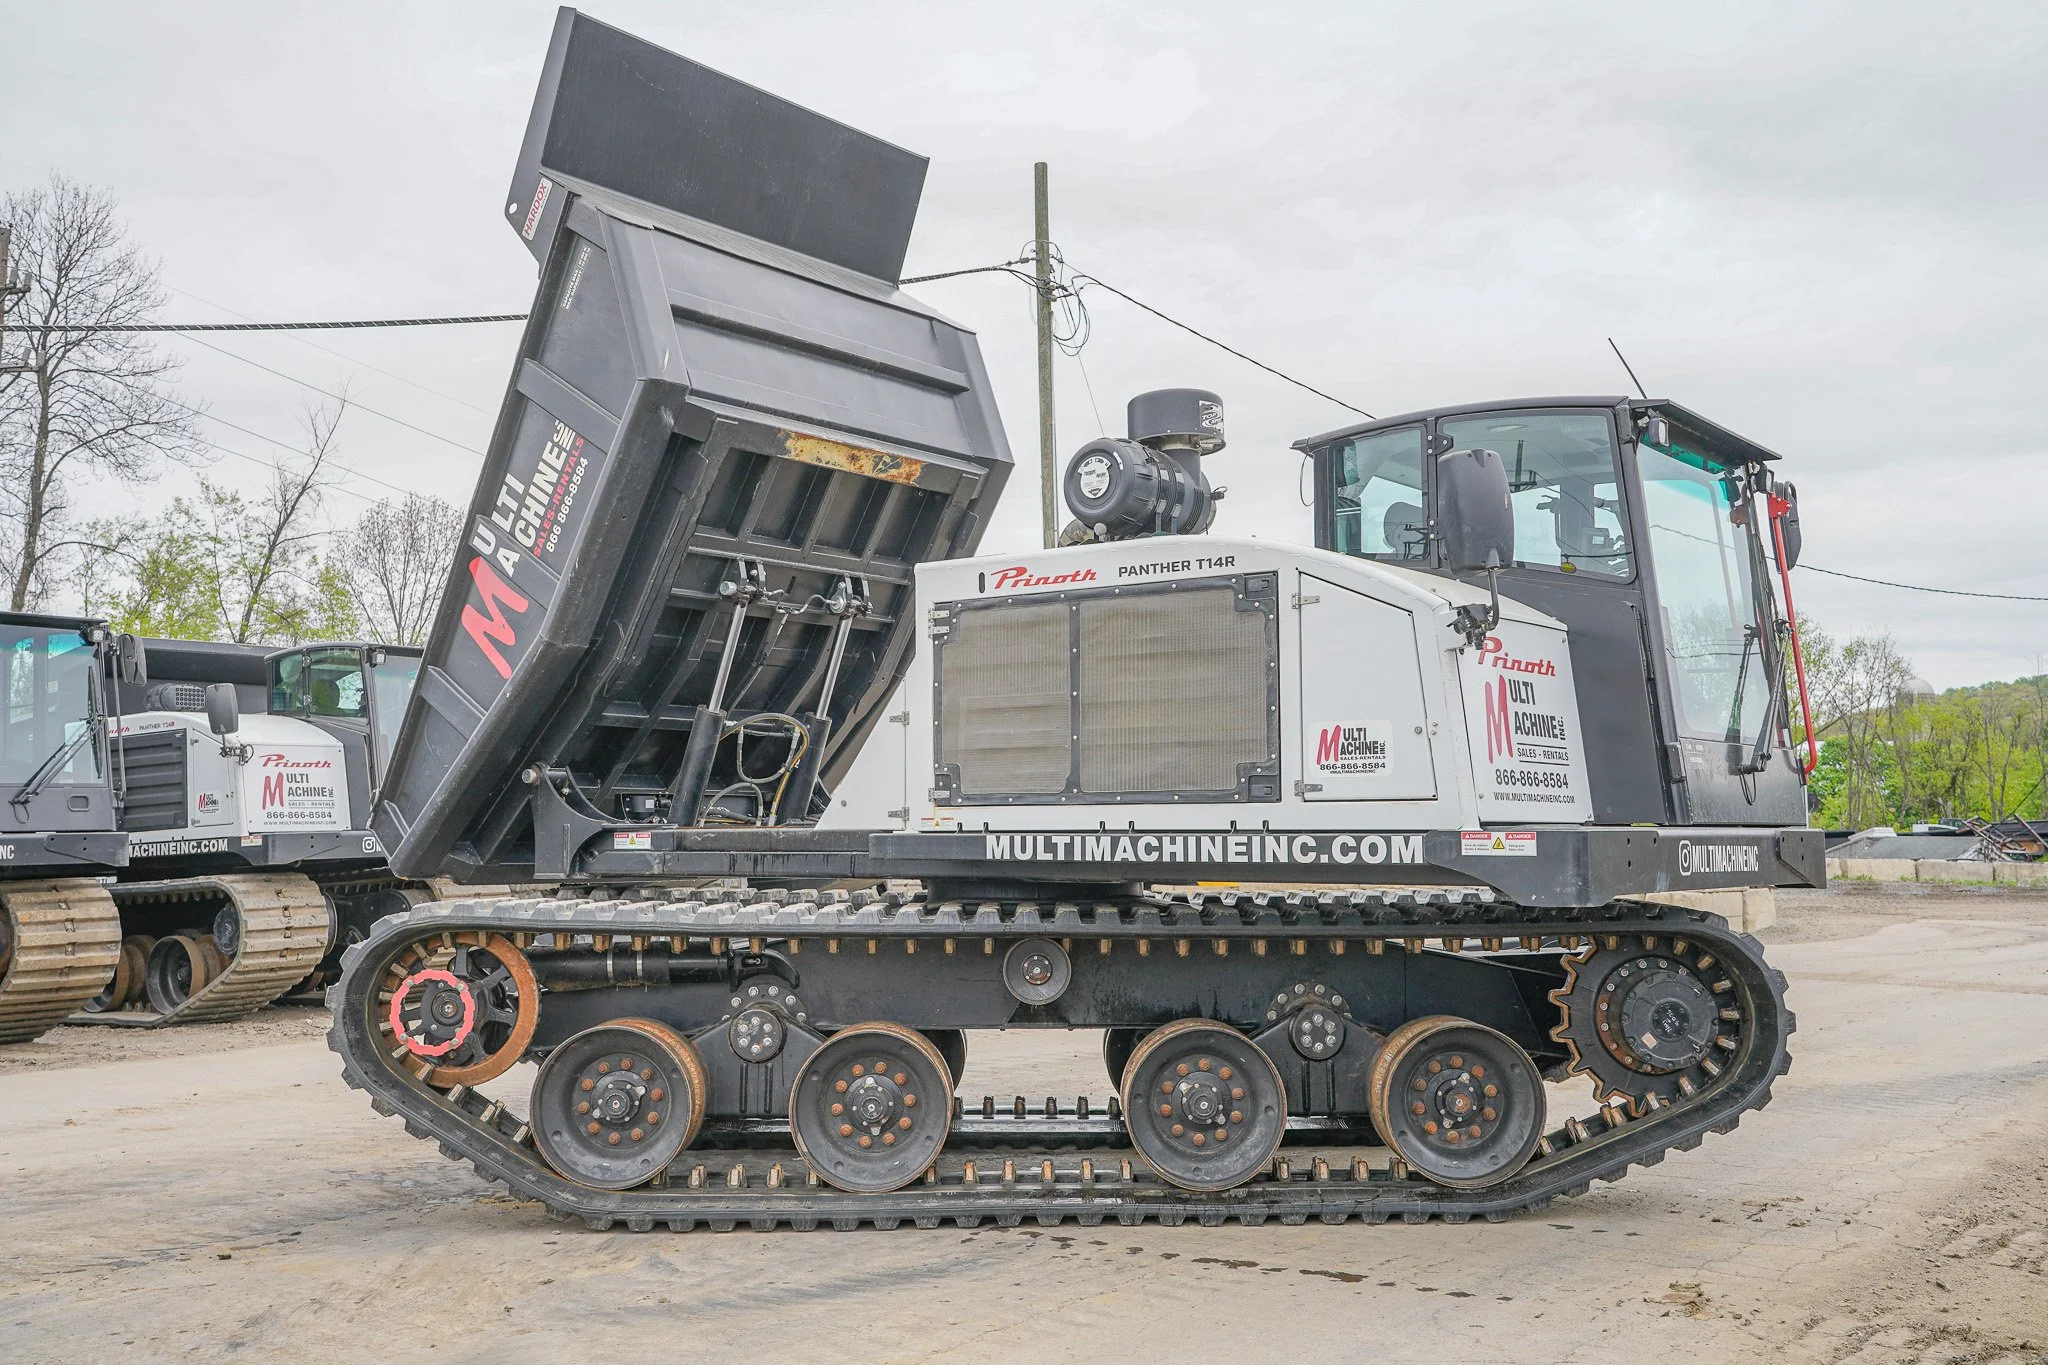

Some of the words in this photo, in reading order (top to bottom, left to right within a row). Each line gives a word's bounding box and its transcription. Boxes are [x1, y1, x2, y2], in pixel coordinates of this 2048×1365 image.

[524, 182, 547, 236] HARDOX
[546, 527, 562, 553] 866
[557, 457, 589, 524] 866-8584
[991, 566, 1097, 590] Prinoth
[1118, 560, 1191, 578] PANTHER
[1196, 555, 1236, 570] T14R
[1477, 636, 1556, 677] Prinoth
[259, 754, 332, 768] Prinoth
[1517, 747, 1537, 759] SALES
[1542, 749, 1569, 761] RENTALS
[1319, 762, 1386, 771] 866-866-8584
[1495, 768, 1569, 789] 866-866-8584
[1493, 791, 1576, 804] WWW.MULTIMACHINEINC.COM
[266, 811, 332, 819] 866-866-8584
[985, 835, 1424, 864] MULTIMACHINEINC.COM
[1692, 845, 1759, 873] MULTIMACHINEINC
